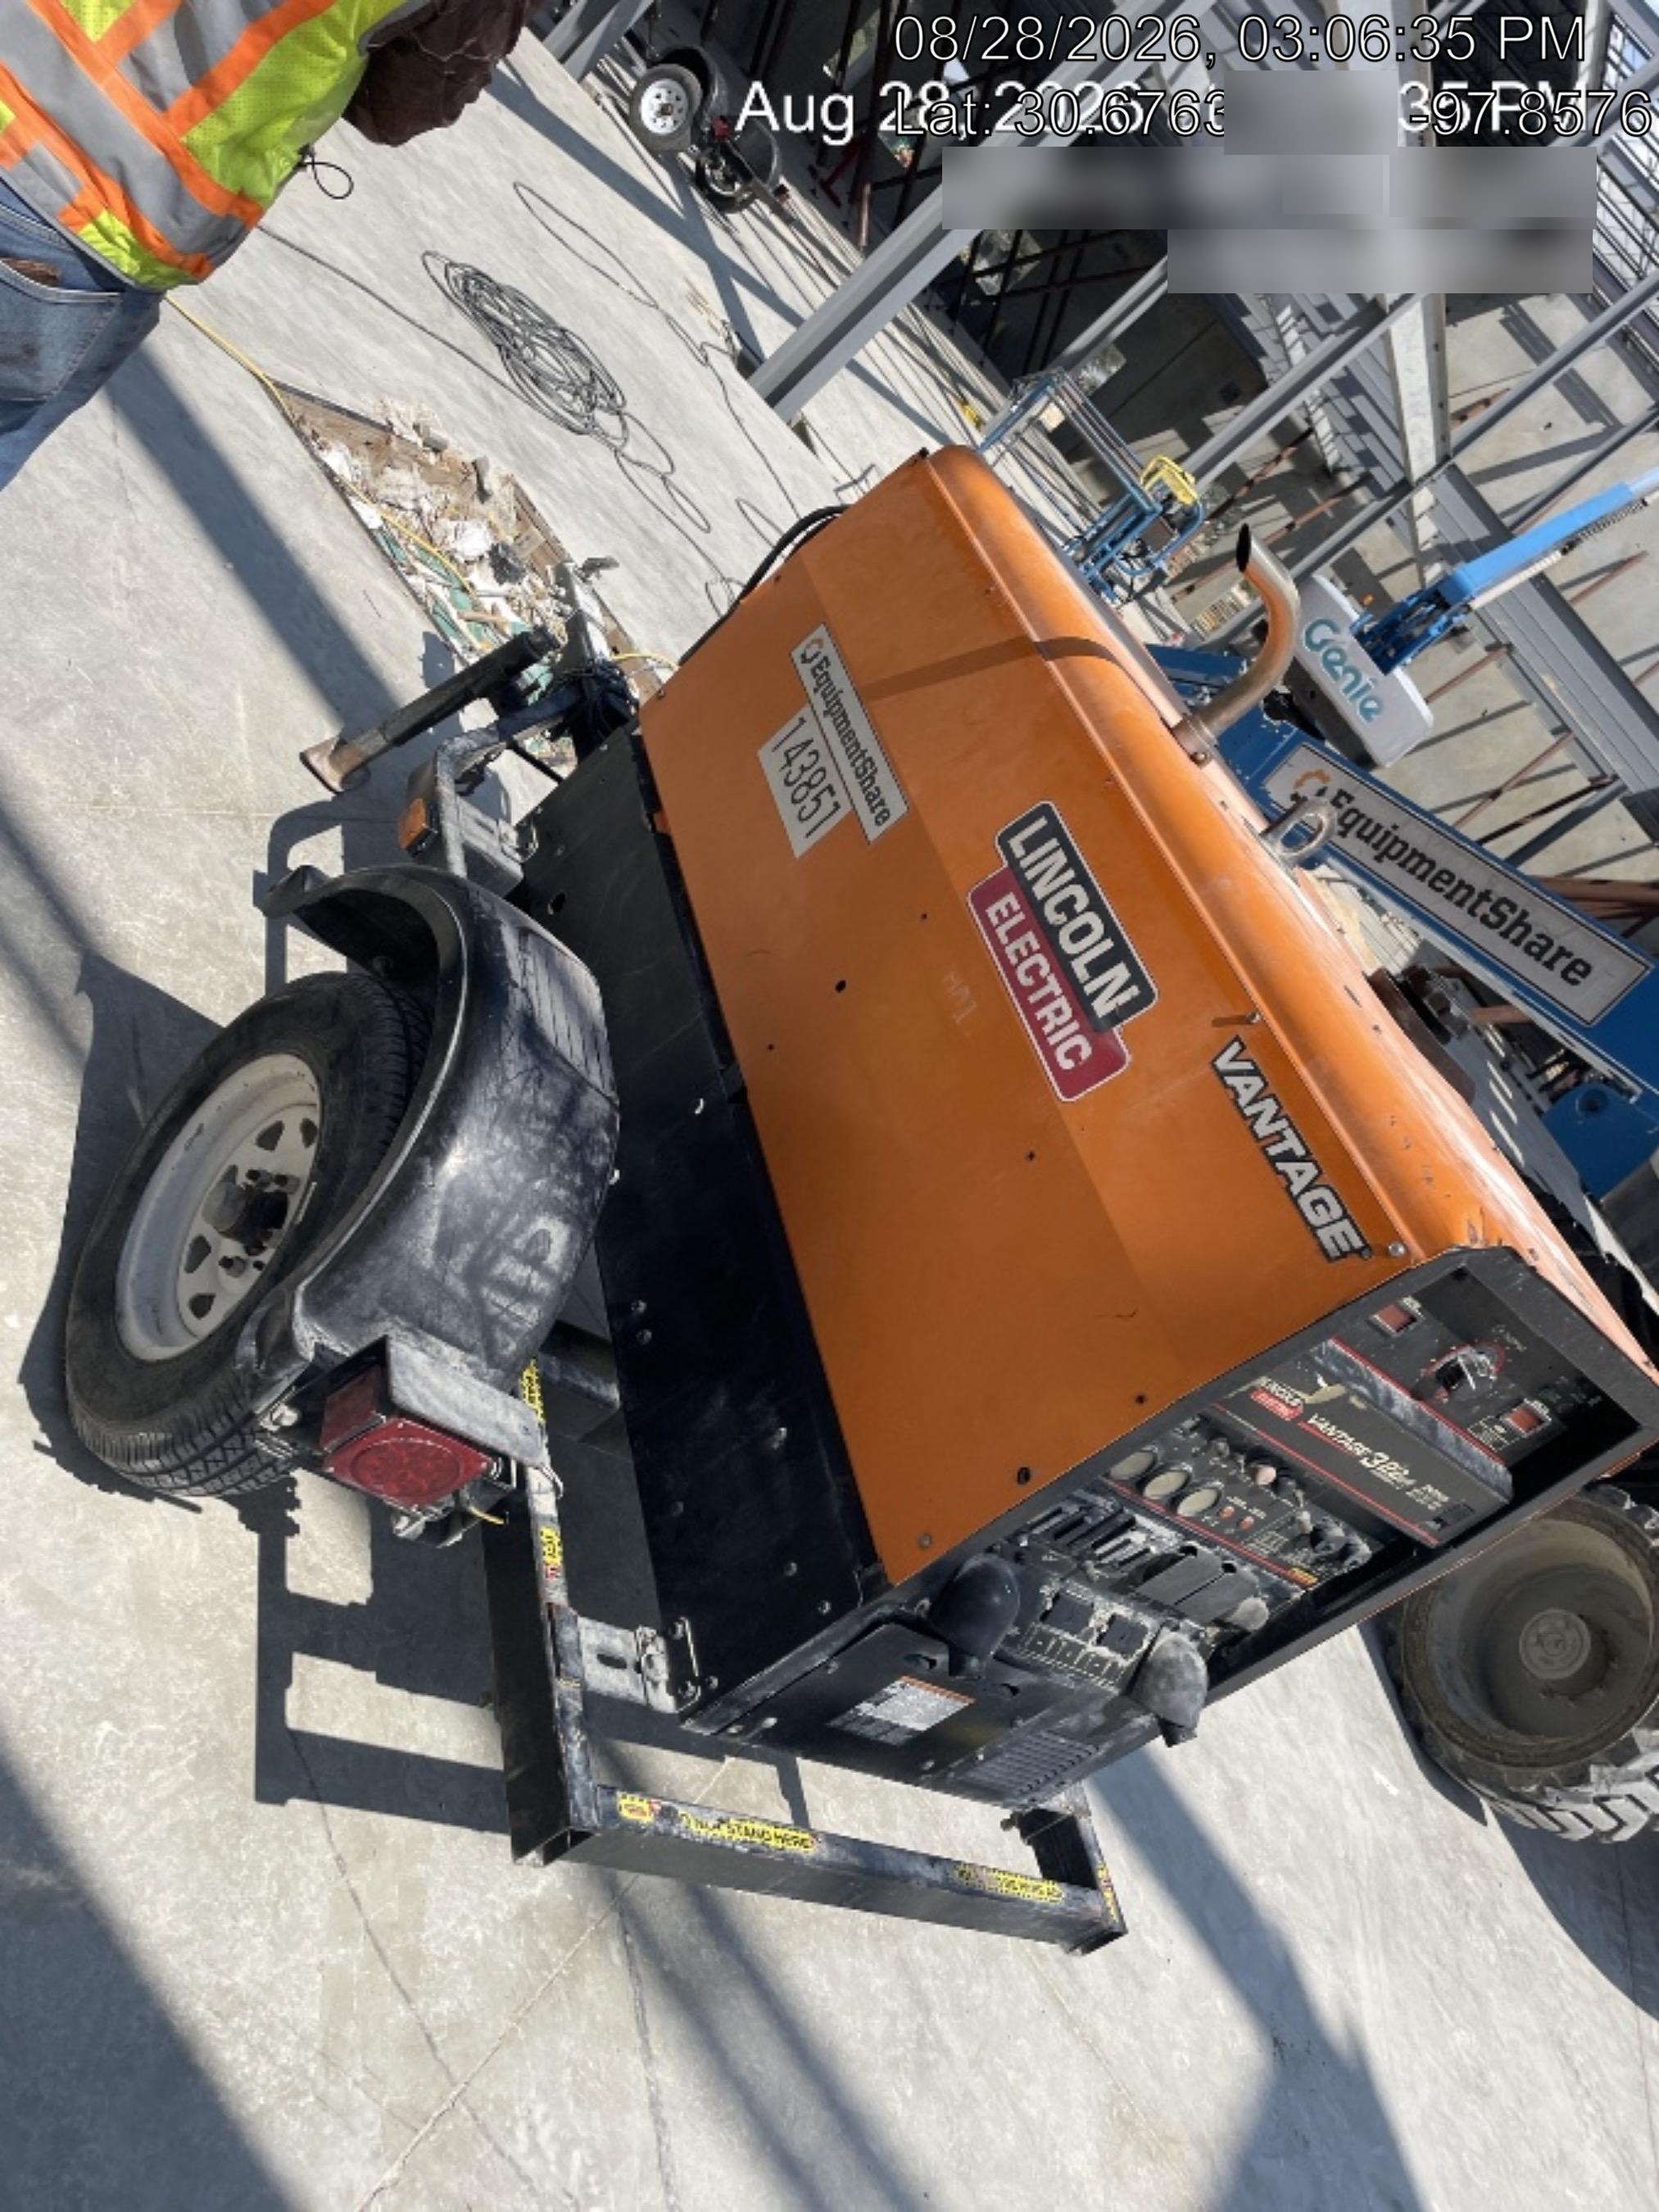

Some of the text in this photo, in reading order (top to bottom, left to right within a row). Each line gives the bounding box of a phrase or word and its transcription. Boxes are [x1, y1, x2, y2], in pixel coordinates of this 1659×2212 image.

[809, 655, 891, 827] EquipmentShare
[1302, 617, 1385, 723] Genie
[771, 716, 841, 839] 143851
[985, 891, 1093, 1072] ELECTRIC
[1006, 816, 1141, 1020] LINCOLN
[1212, 1036, 1368, 1262] VANTAGE
